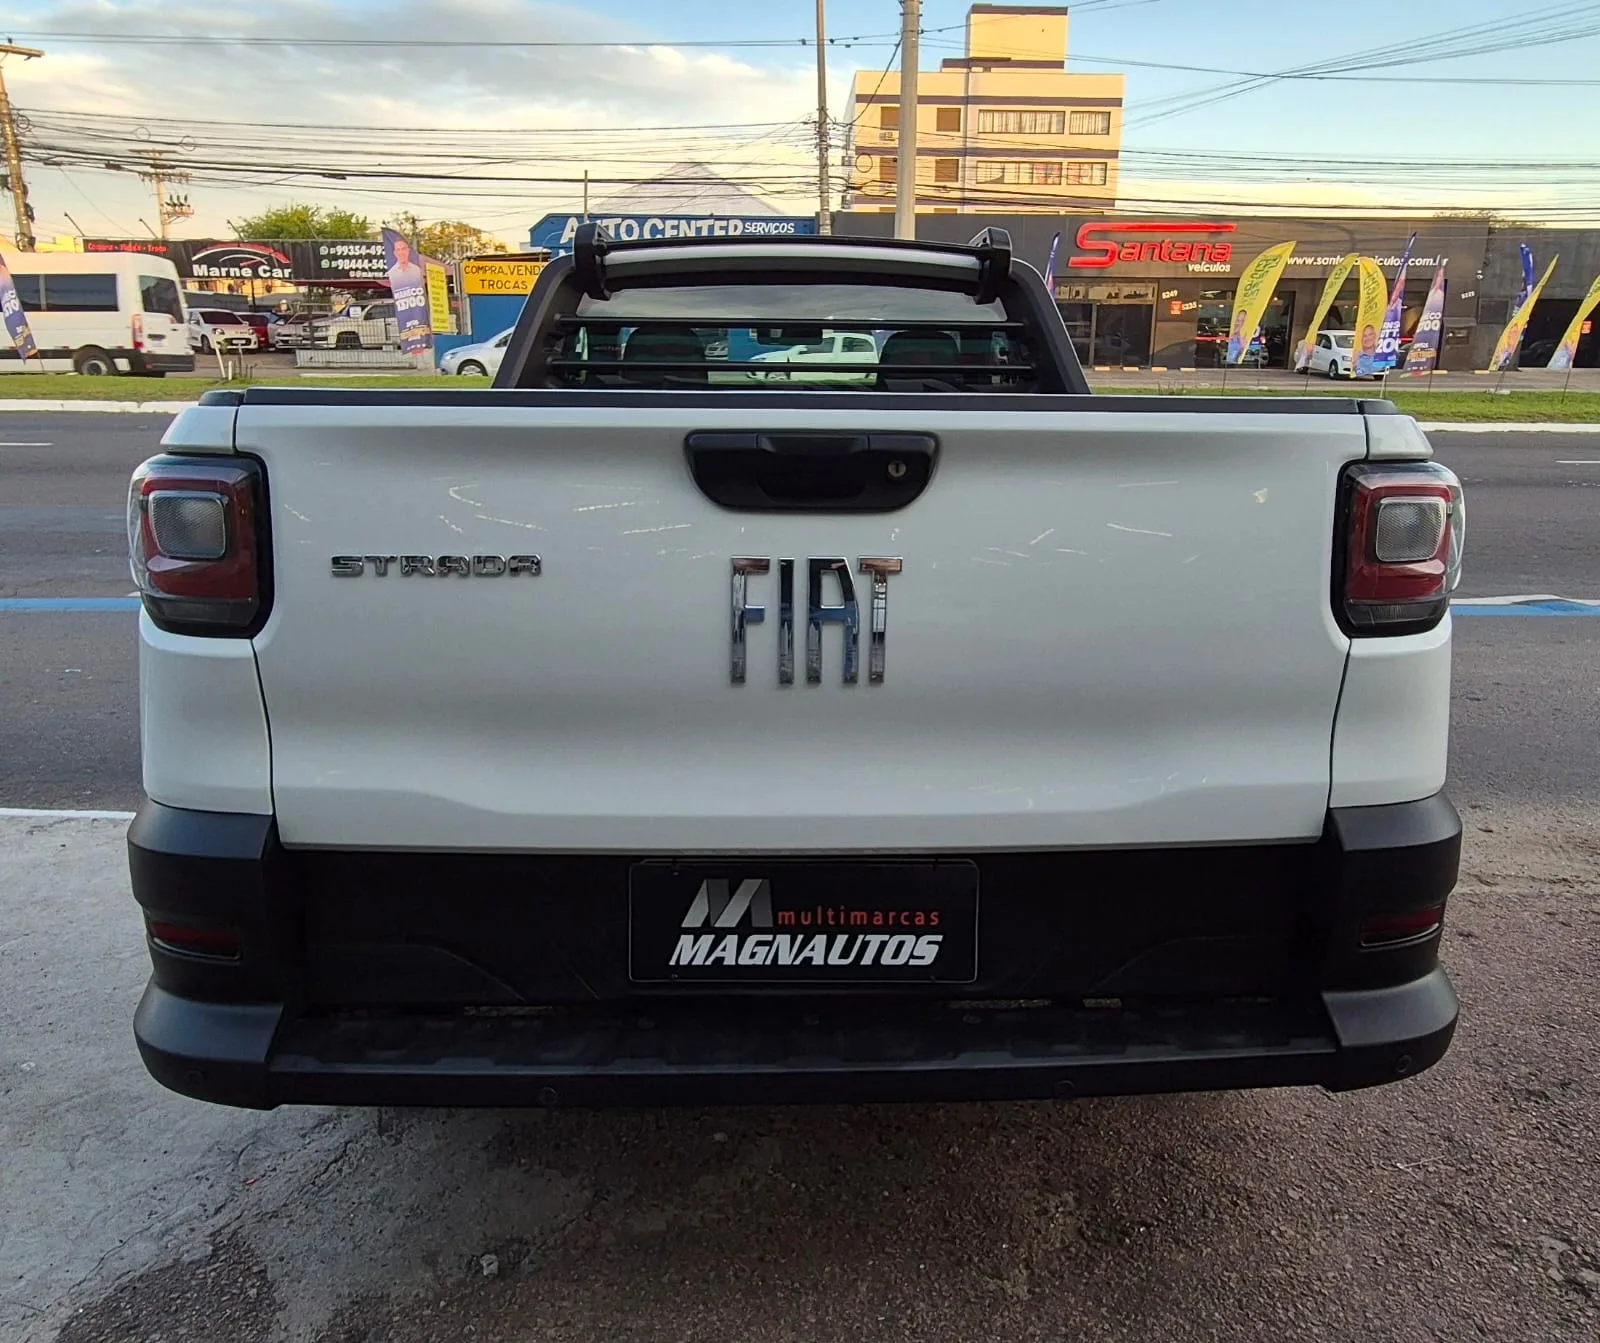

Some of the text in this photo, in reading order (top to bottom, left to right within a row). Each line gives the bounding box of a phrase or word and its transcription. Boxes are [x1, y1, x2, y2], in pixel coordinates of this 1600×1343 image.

[560, 217, 640, 244] ATO
[744, 222, 795, 235] SERVIÇOS
[1067, 222, 1238, 269] Santana
[192, 264, 293, 278] Marne Car
[1187, 261, 1231, 273] veículos
[479, 279, 528, 290] TROCAS
[331, 554, 542, 577] STRADA
[730, 556, 904, 684] FIAT
[777, 905, 941, 927] multimarcas
[669, 934, 945, 966] MAGNAUTOS
